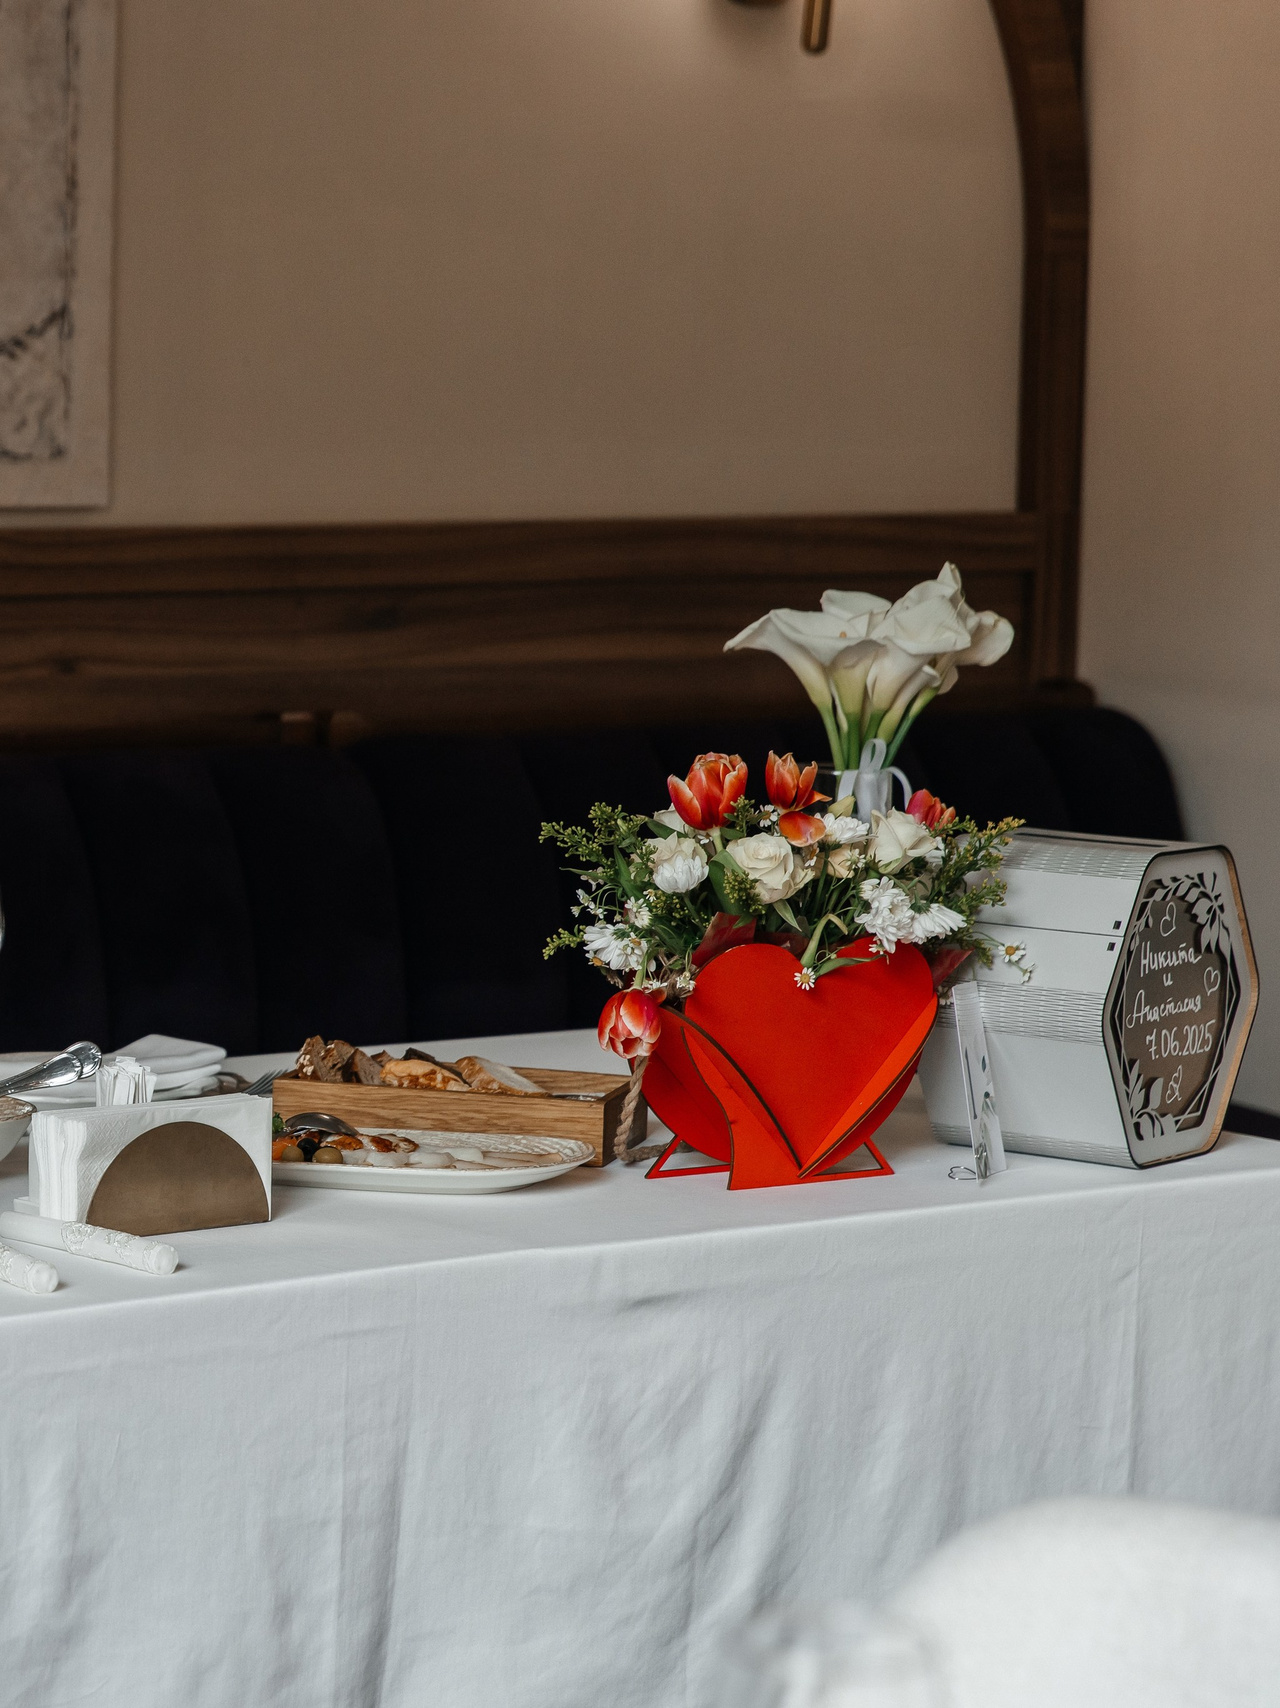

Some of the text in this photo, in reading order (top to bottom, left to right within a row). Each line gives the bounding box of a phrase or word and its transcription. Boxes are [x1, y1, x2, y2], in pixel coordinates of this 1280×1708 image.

[1140, 941, 1202, 977] Никита
[1162, 972, 1173, 987] и
[1126, 989, 1202, 1029] Анастасия
[1145, 1019, 1216, 1061] 7.06.2025
